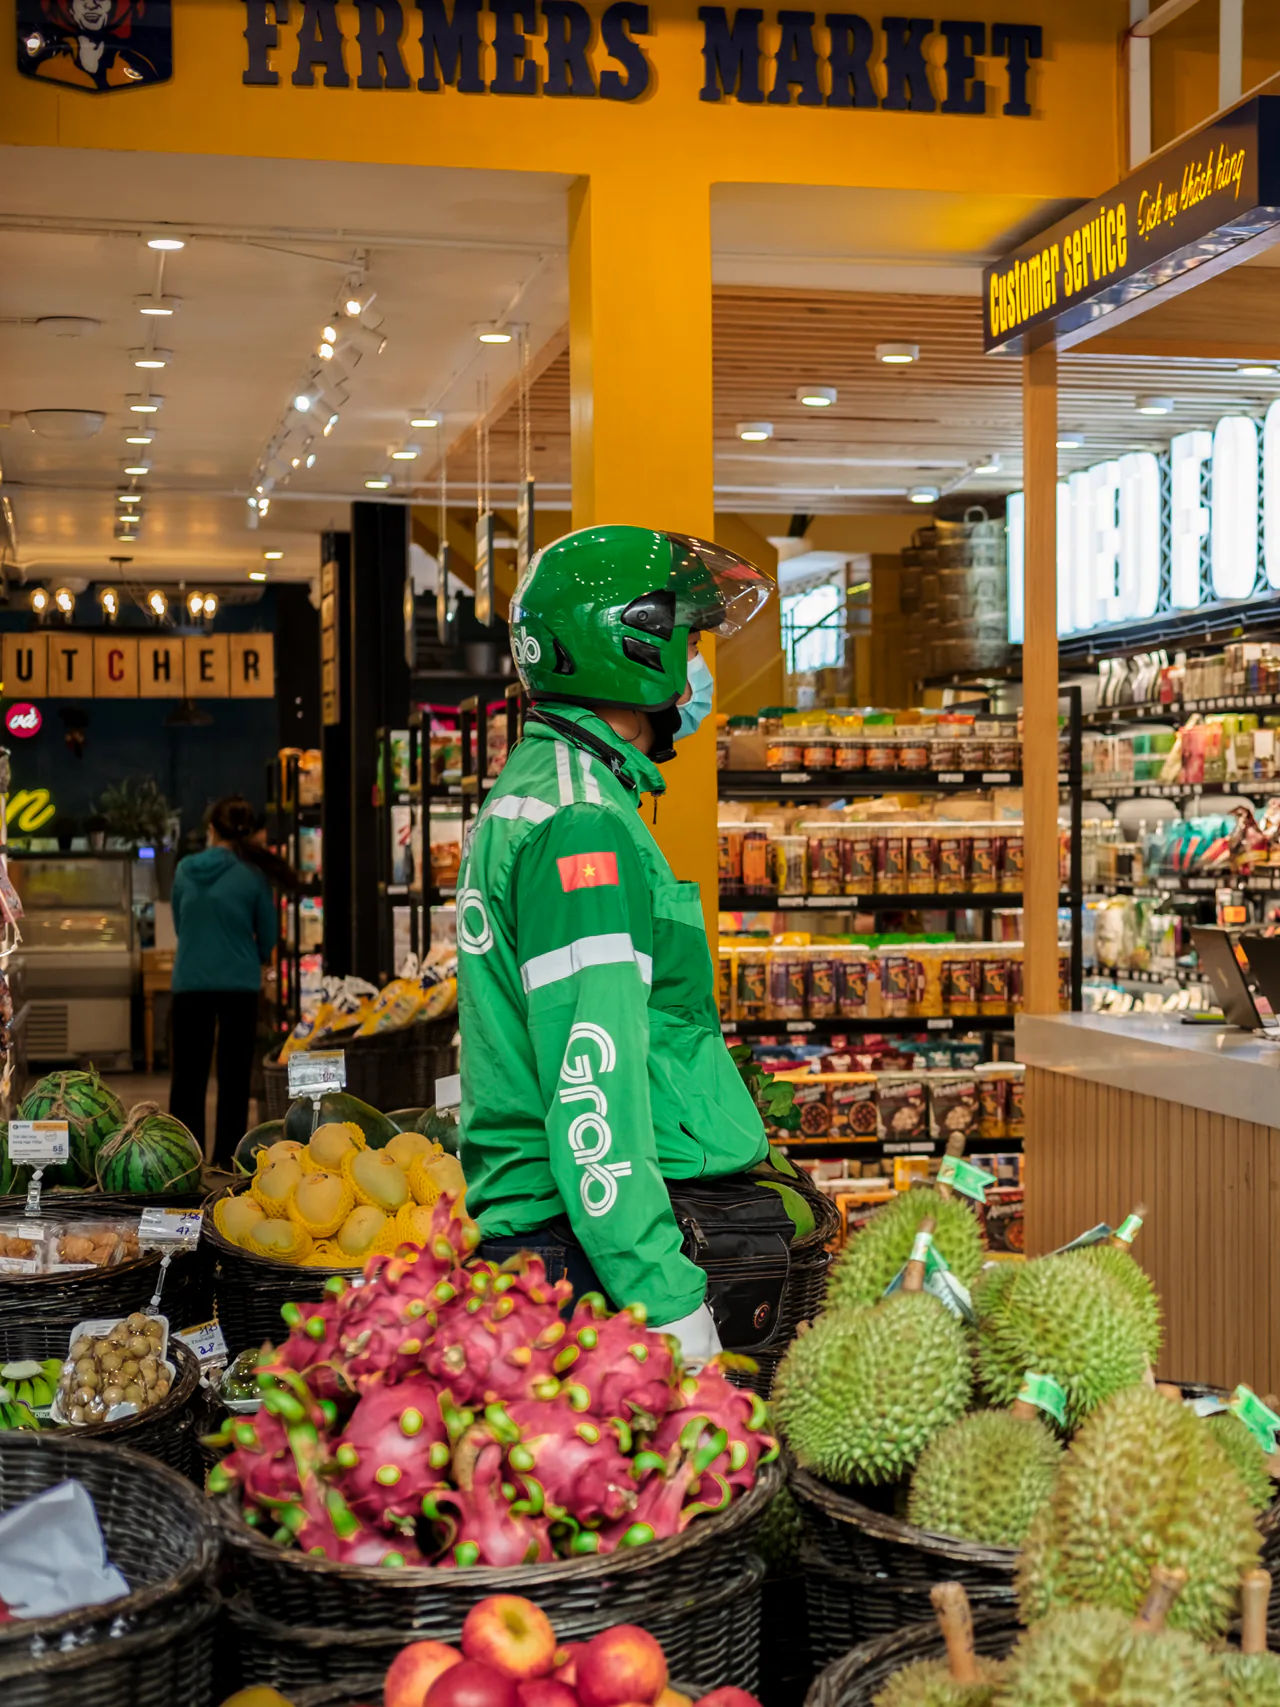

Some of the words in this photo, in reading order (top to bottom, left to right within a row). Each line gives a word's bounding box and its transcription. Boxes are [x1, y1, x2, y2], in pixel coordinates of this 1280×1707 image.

[242, 0, 651, 101] FARMERS
[699, 6, 1044, 117] MARKET
[989, 243, 1060, 338] Customer
[1064, 203, 1127, 297] service
[15, 647, 261, 683] UTCHER
[559, 1022, 632, 1217] Grab
